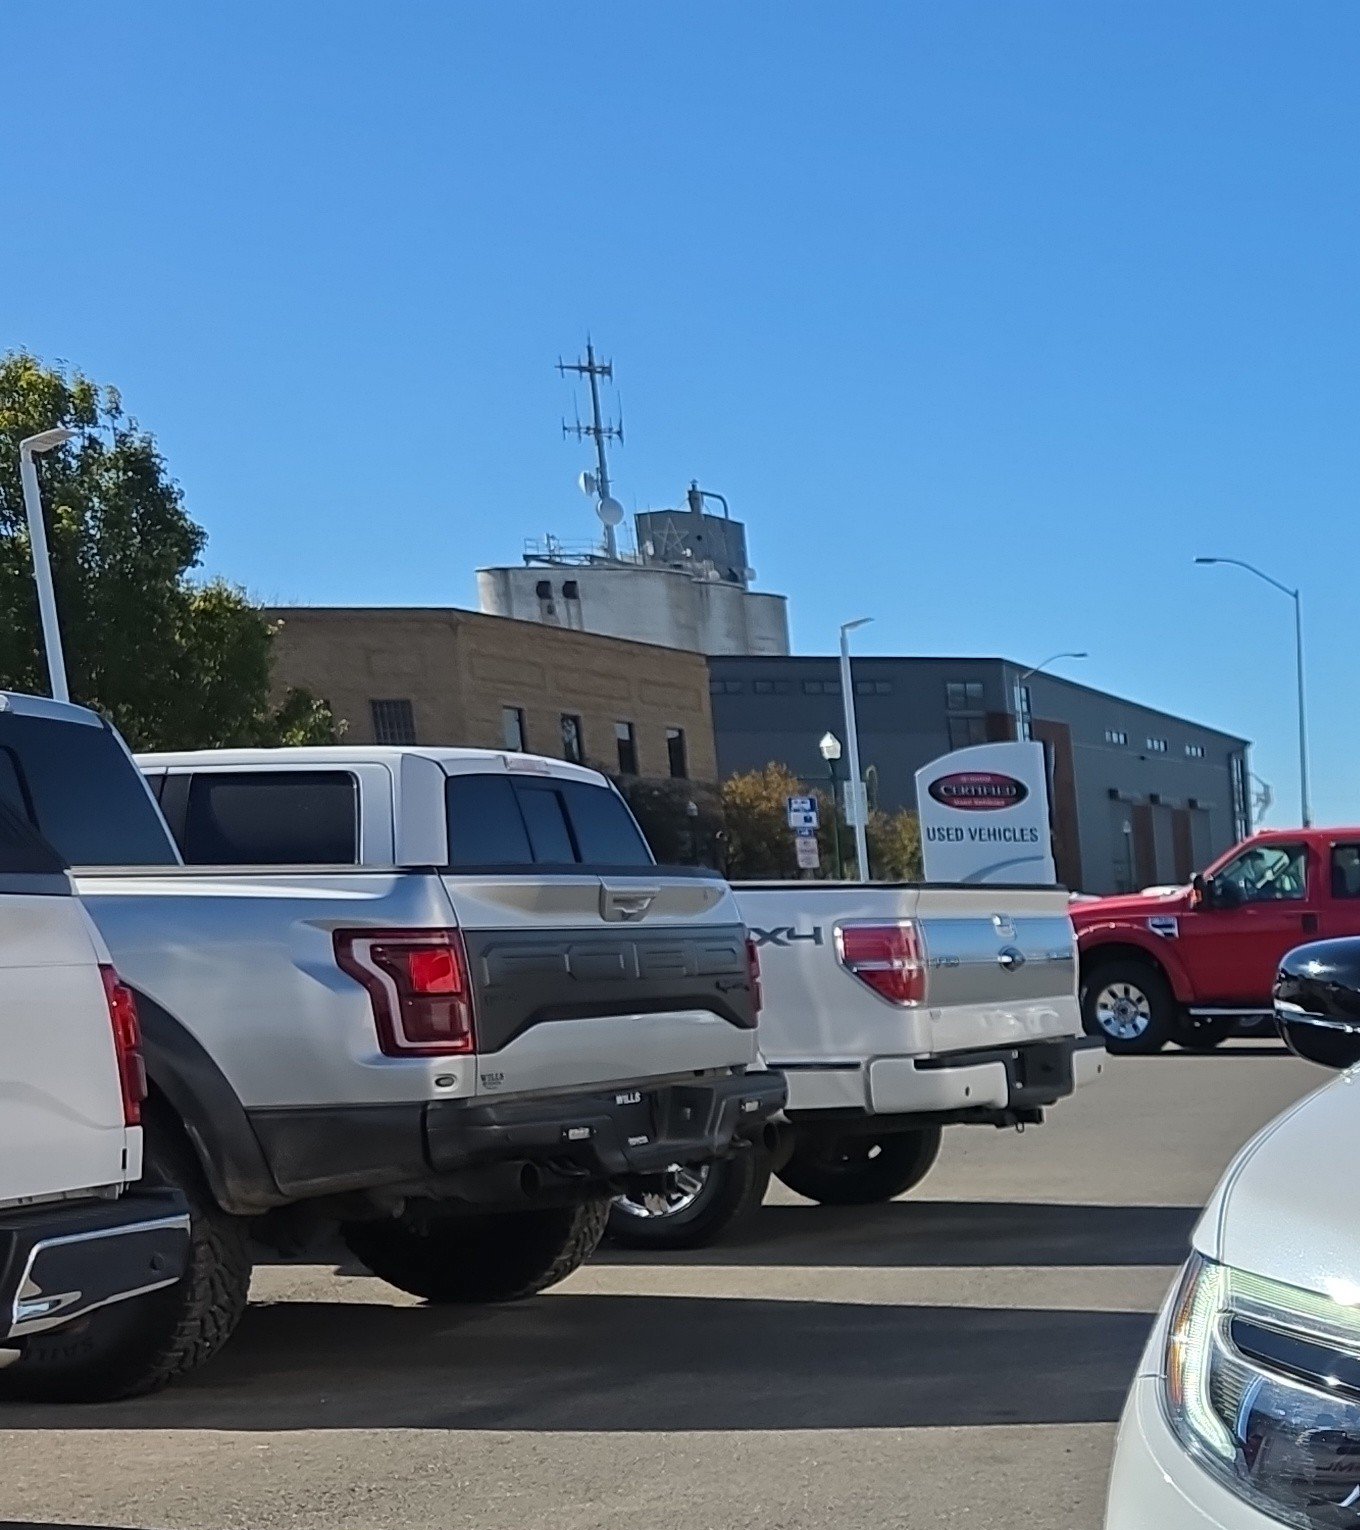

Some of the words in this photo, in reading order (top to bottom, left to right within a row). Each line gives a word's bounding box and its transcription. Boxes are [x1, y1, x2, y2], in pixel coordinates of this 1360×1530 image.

[926, 826, 964, 842] USED
[968, 826, 1039, 842] VEHICLES
[747, 926, 824, 946] X4
[616, 1091, 641, 1105] WILLS
